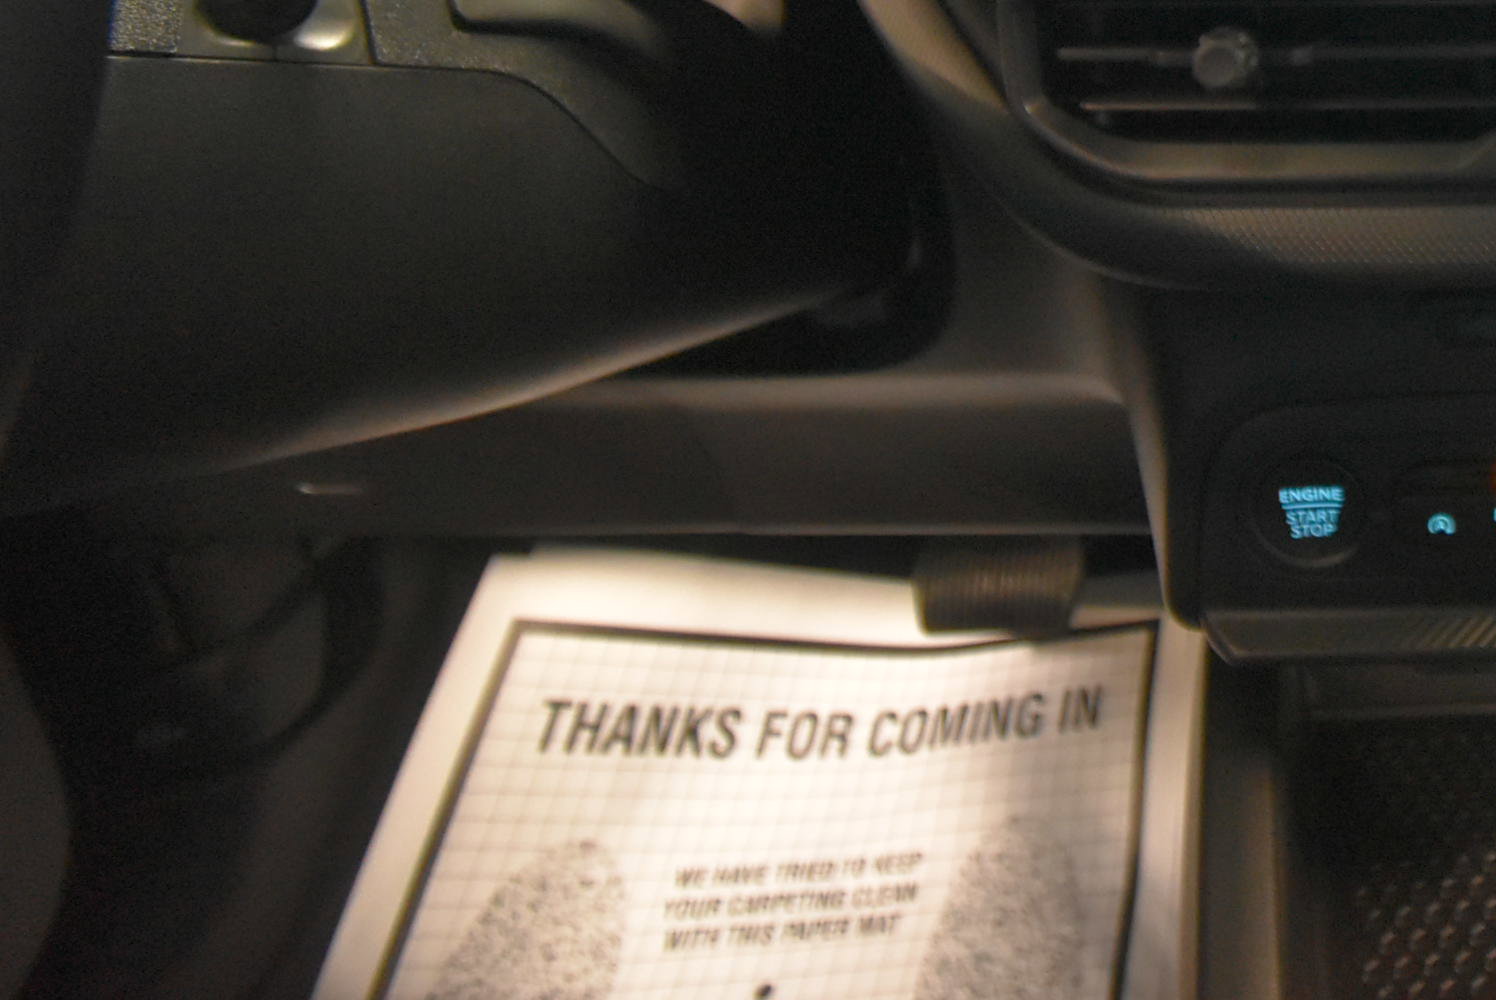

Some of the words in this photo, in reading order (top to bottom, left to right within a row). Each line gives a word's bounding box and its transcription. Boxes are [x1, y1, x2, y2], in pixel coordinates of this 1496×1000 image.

[1279, 486, 1345, 503] ENGINE
[1285, 509, 1341, 525] START
[1290, 523, 1338, 539] STOP
[538, 699, 740, 759] THANKS
[755, 708, 853, 761] FOR
[866, 693, 1043, 758] COMING
[1057, 683, 1104, 736] IN
